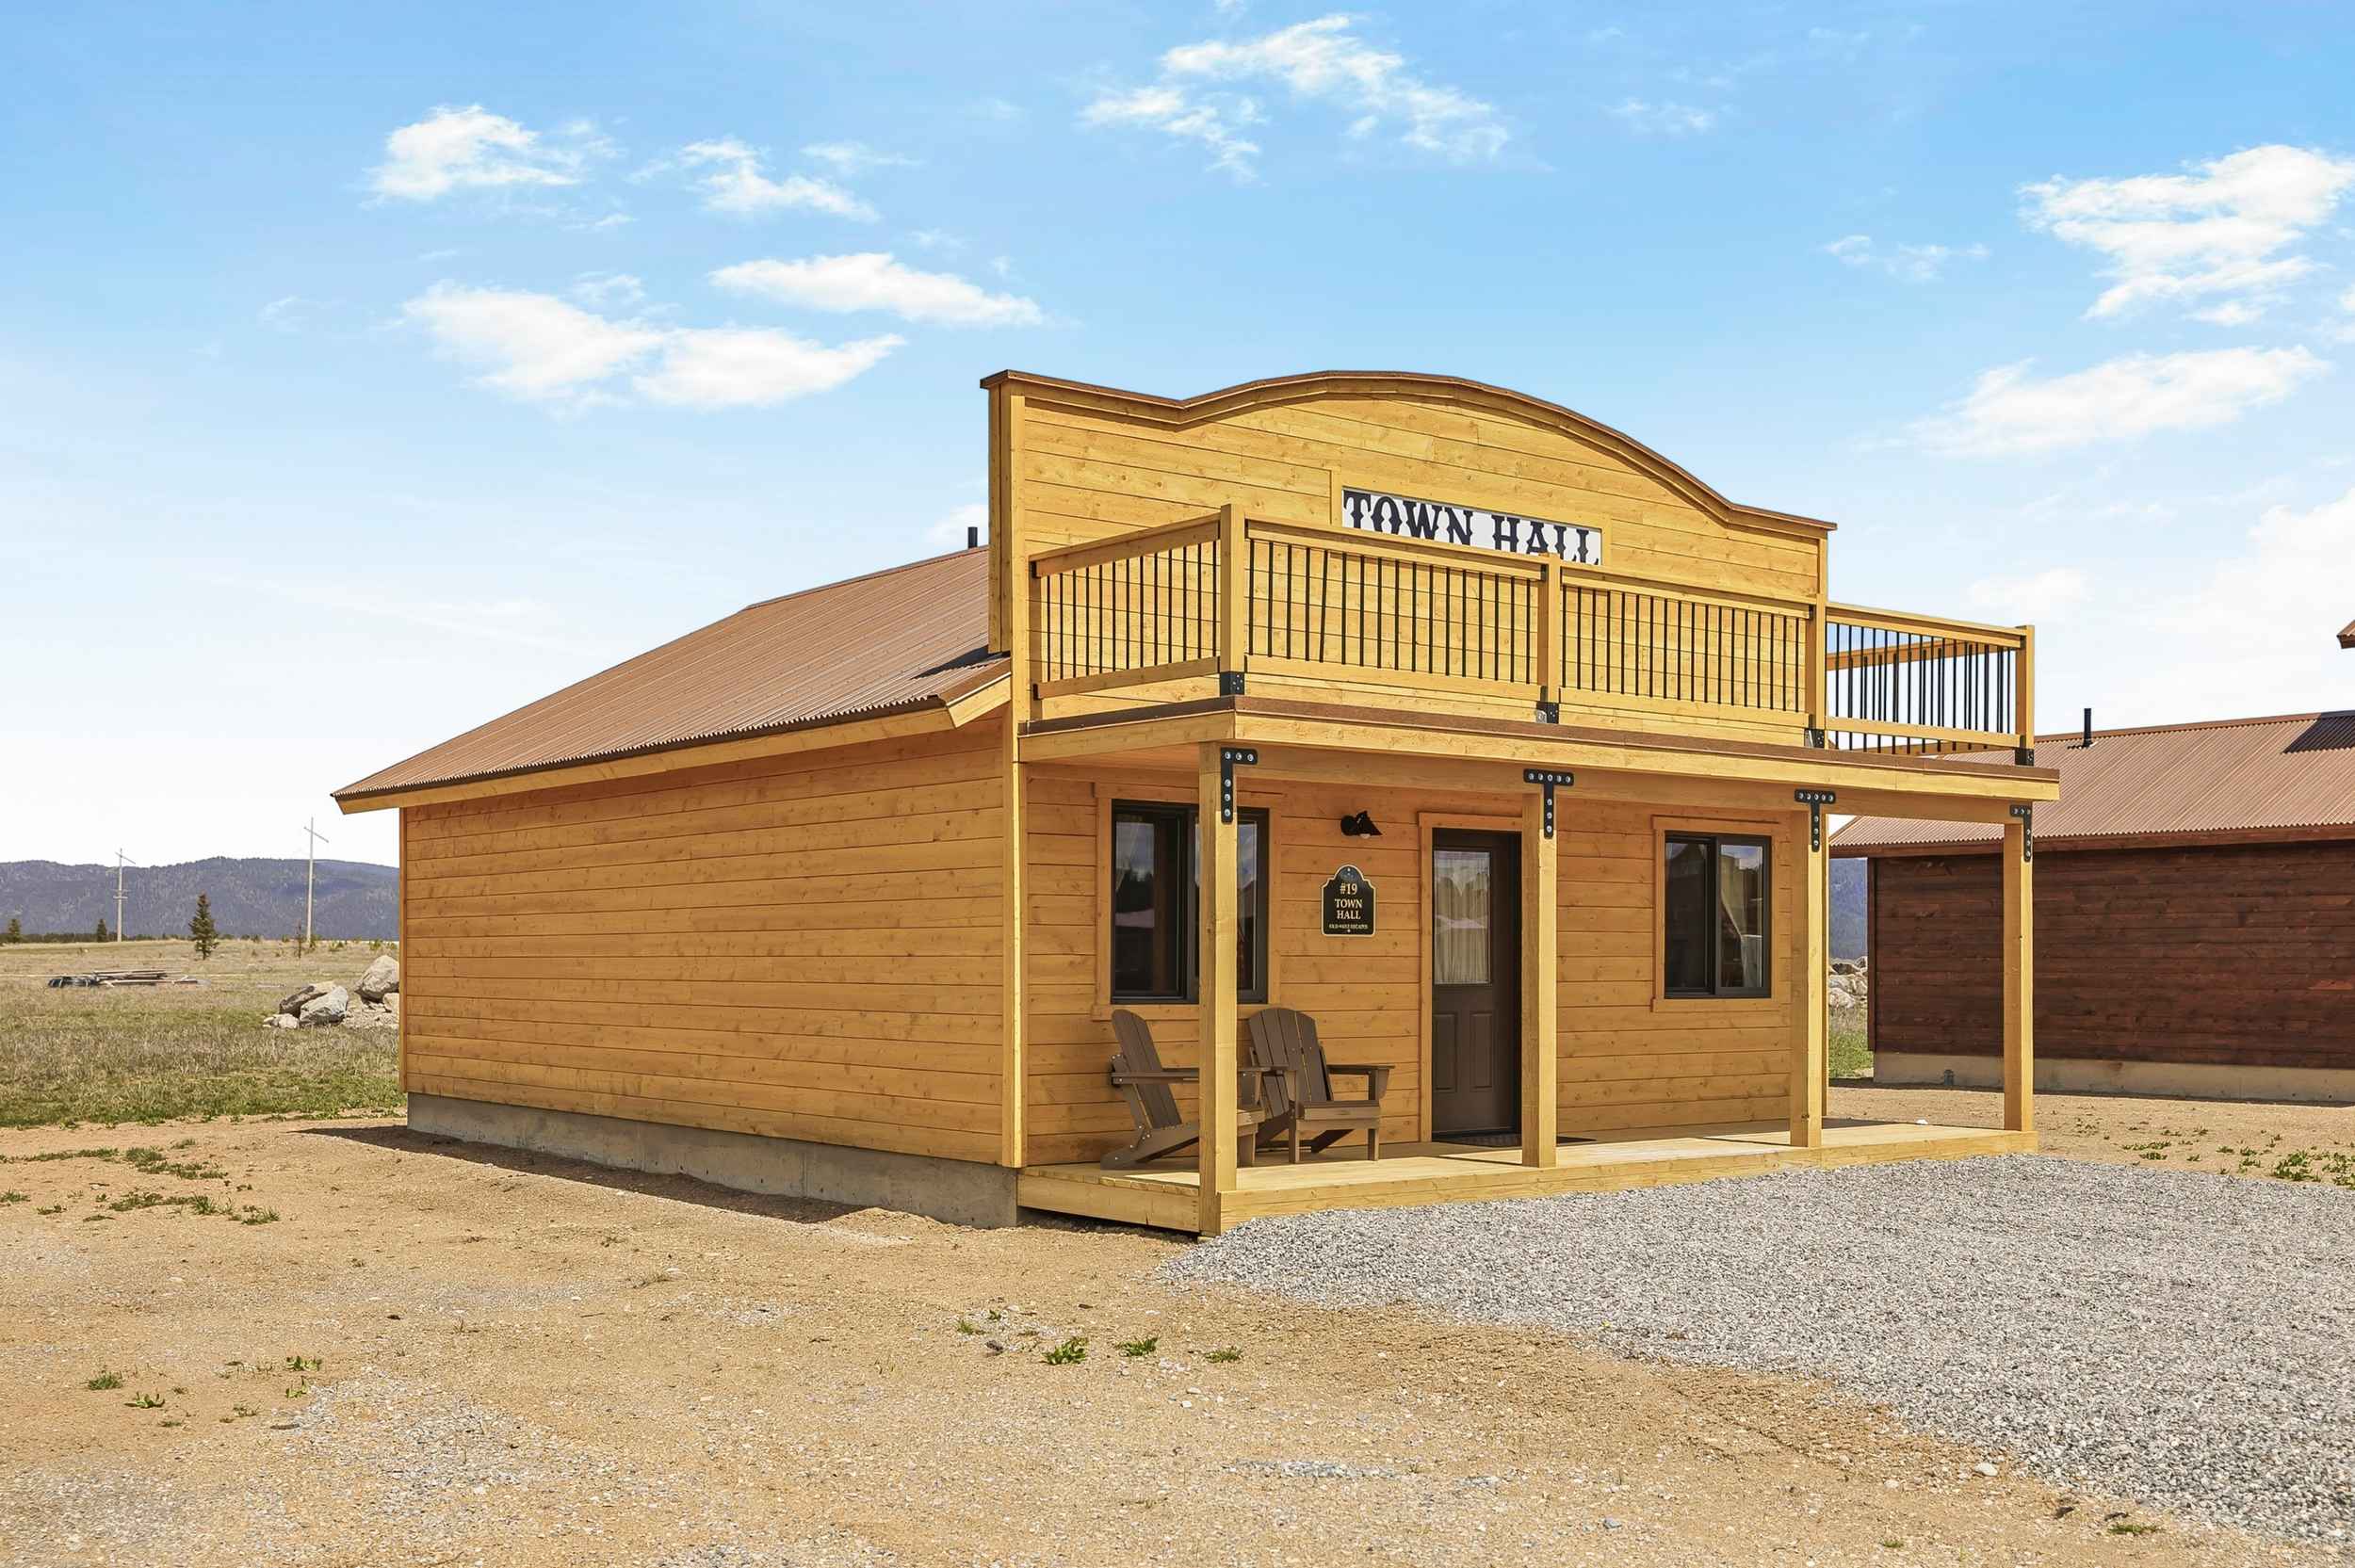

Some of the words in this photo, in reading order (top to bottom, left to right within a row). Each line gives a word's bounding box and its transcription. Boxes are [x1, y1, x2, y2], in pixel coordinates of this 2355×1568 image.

[1343, 490, 1472, 544] TOWN
[1340, 883, 1357, 895] #19
[1335, 899, 1362, 909] TOWN
[1337, 911, 1360, 920] HALL
